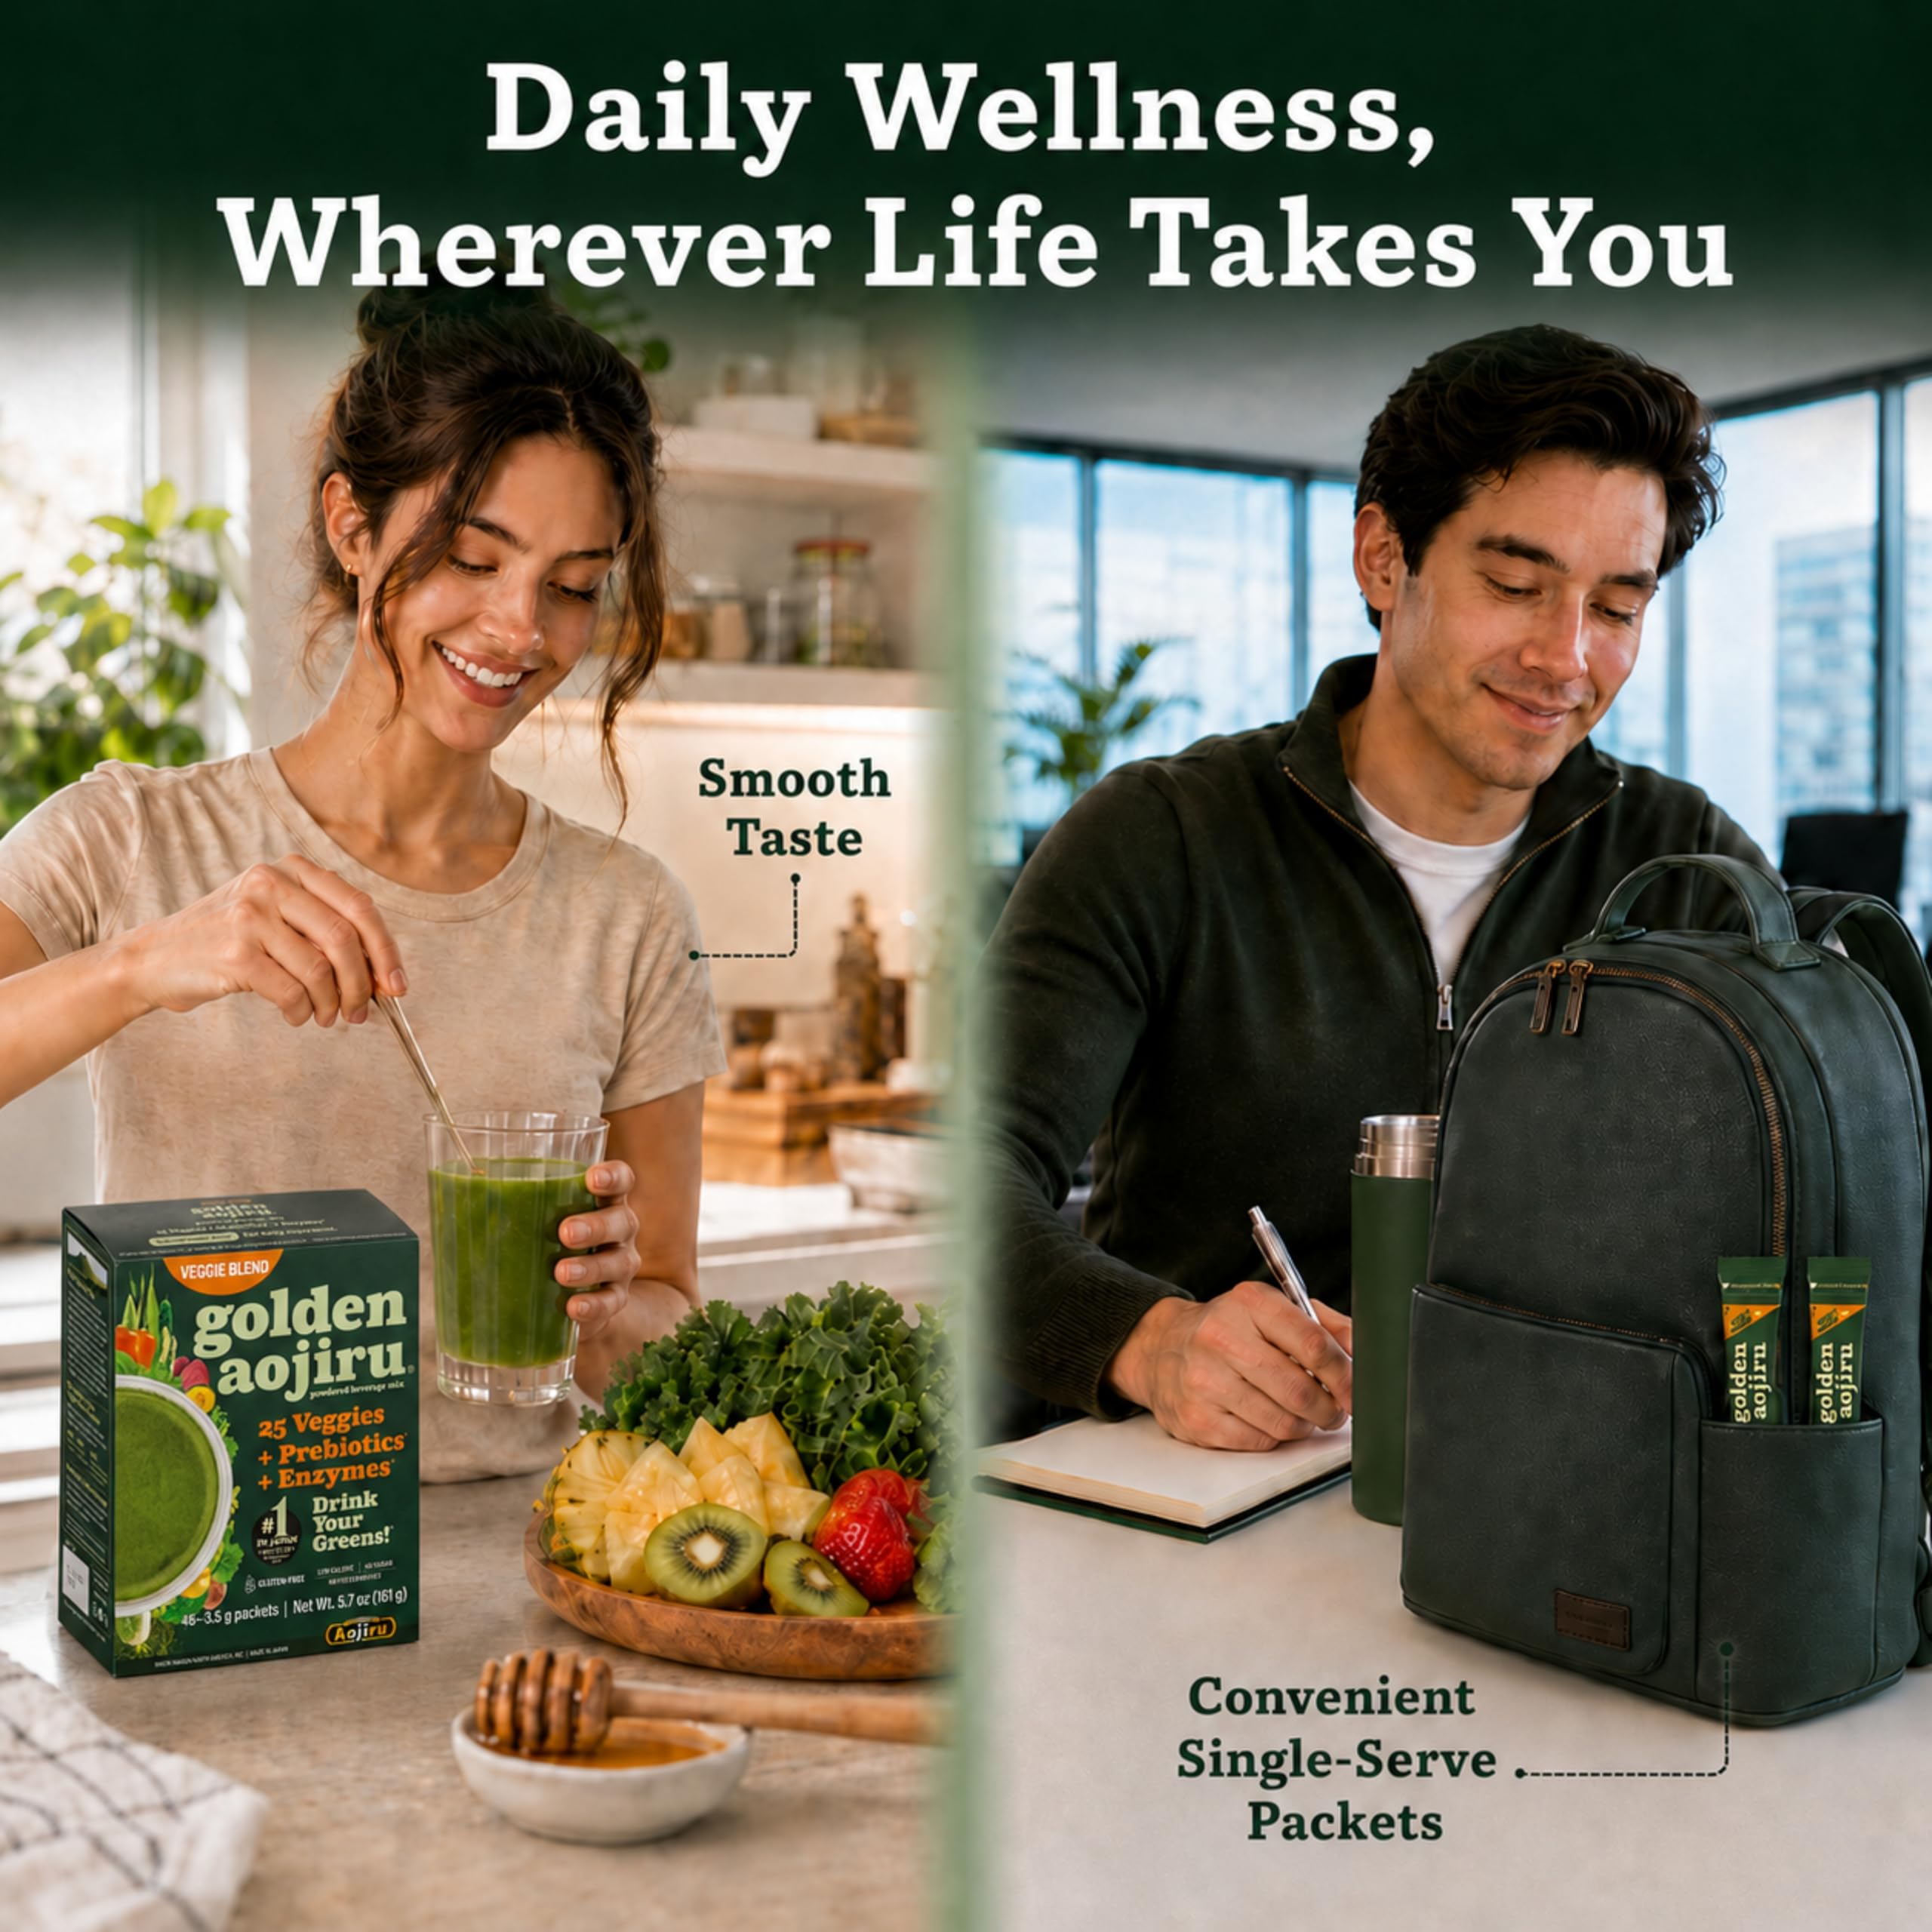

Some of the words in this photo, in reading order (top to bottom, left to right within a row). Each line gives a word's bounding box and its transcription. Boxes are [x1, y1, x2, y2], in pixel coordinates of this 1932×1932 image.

[180, 1262, 226, 1279] VEGGIE
[229, 1260, 269, 1277] BLEND
[193, 1284, 407, 1358] golden
[1729, 1342, 1751, 1423] golden
[1748, 1342, 1772, 1420] aojiru
[1816, 1343, 1838, 1424] golden
[1835, 1343, 1858, 1419] aojiru
[258, 1418, 287, 1440] 25
[291, 1405, 385, 1435] Veggies
[312, 1490, 378, 1515] Drink
[312, 1512, 364, 1534] Your
[234, 1604, 279, 1623] packets
[293, 1598, 313, 1614] Net
[337, 1593, 355, 1609] 5.7
[356, 1595, 371, 1606] oz
[334, 1623, 388, 1642] Aojiru
